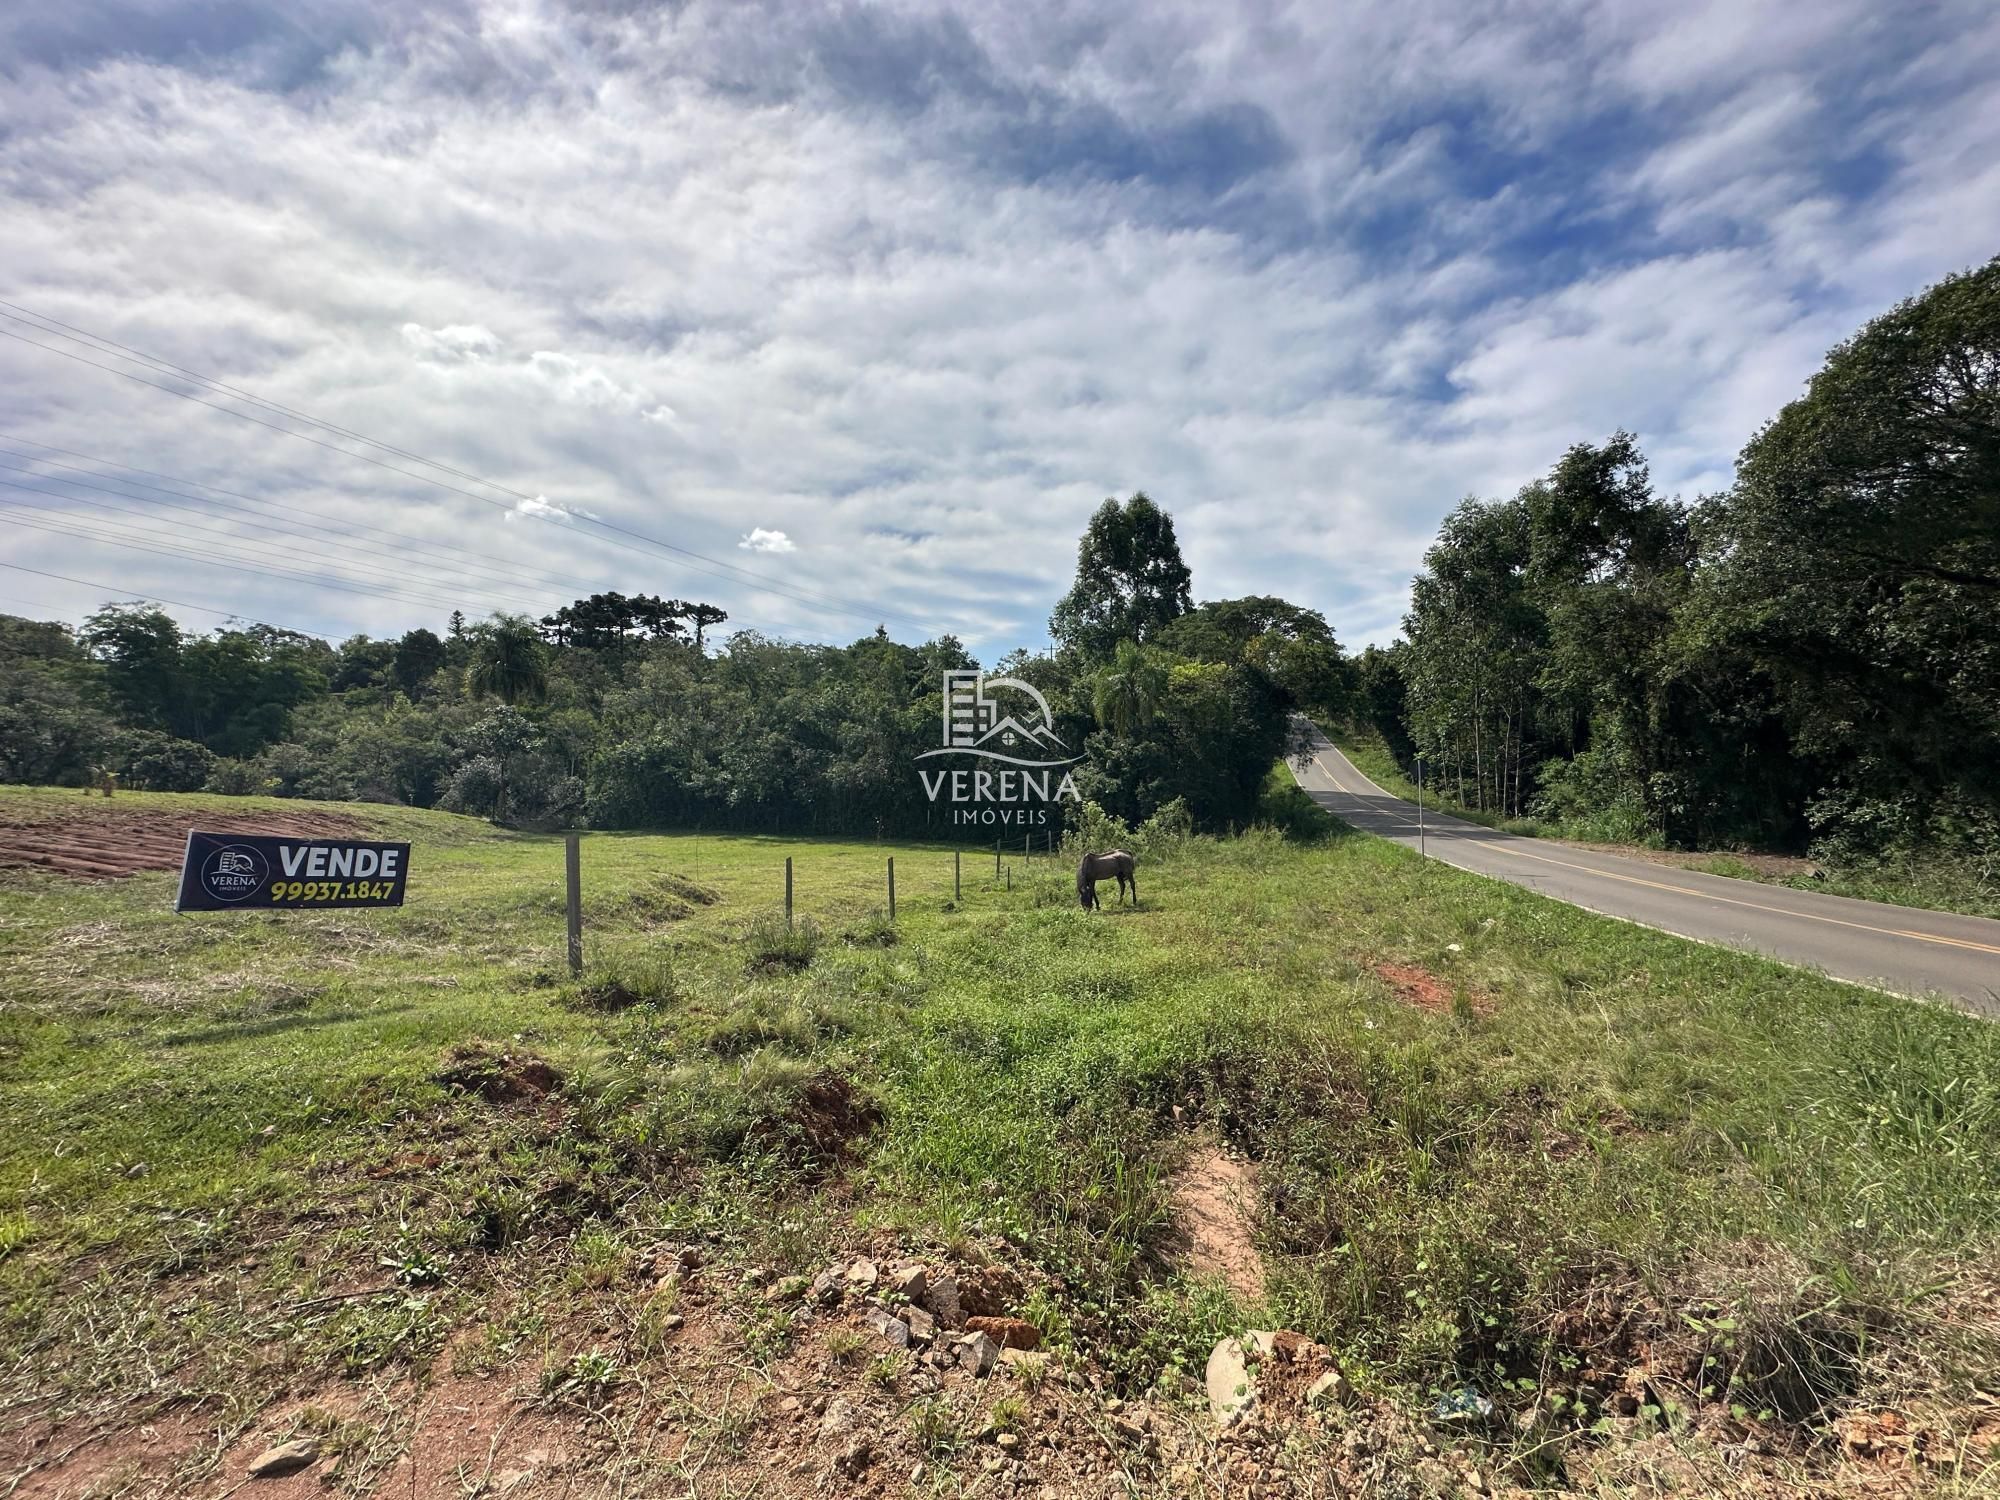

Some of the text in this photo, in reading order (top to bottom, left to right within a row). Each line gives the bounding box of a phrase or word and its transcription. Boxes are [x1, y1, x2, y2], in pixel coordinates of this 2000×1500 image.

[279, 845, 399, 878] VENDE
[211, 876, 256, 886] VERENA
[271, 881, 395, 901] 99937.1847
